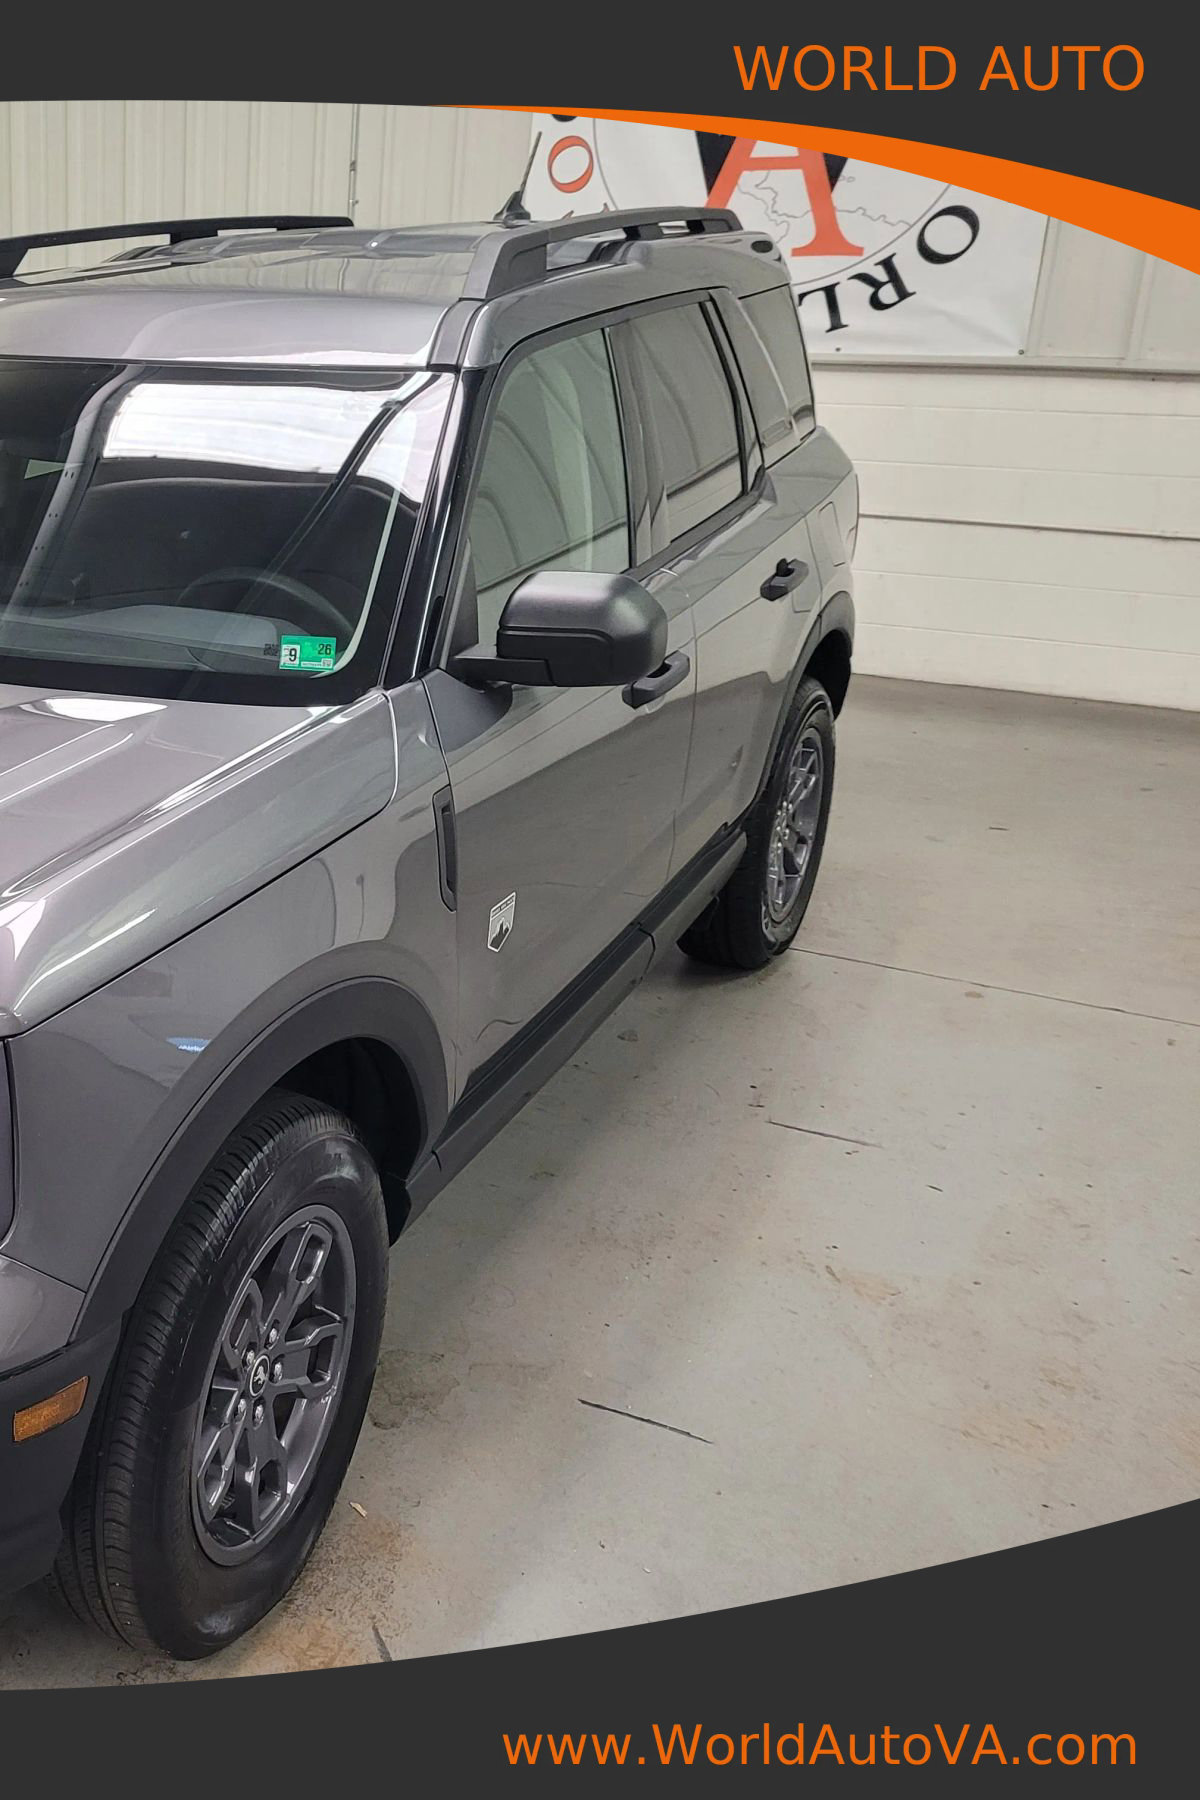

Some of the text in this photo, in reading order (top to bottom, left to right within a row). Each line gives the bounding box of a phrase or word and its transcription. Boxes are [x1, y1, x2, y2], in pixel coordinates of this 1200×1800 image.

[798, 205, 980, 333] ORL
[289, 648, 298, 662] 9
[318, 644, 332, 655] 26
